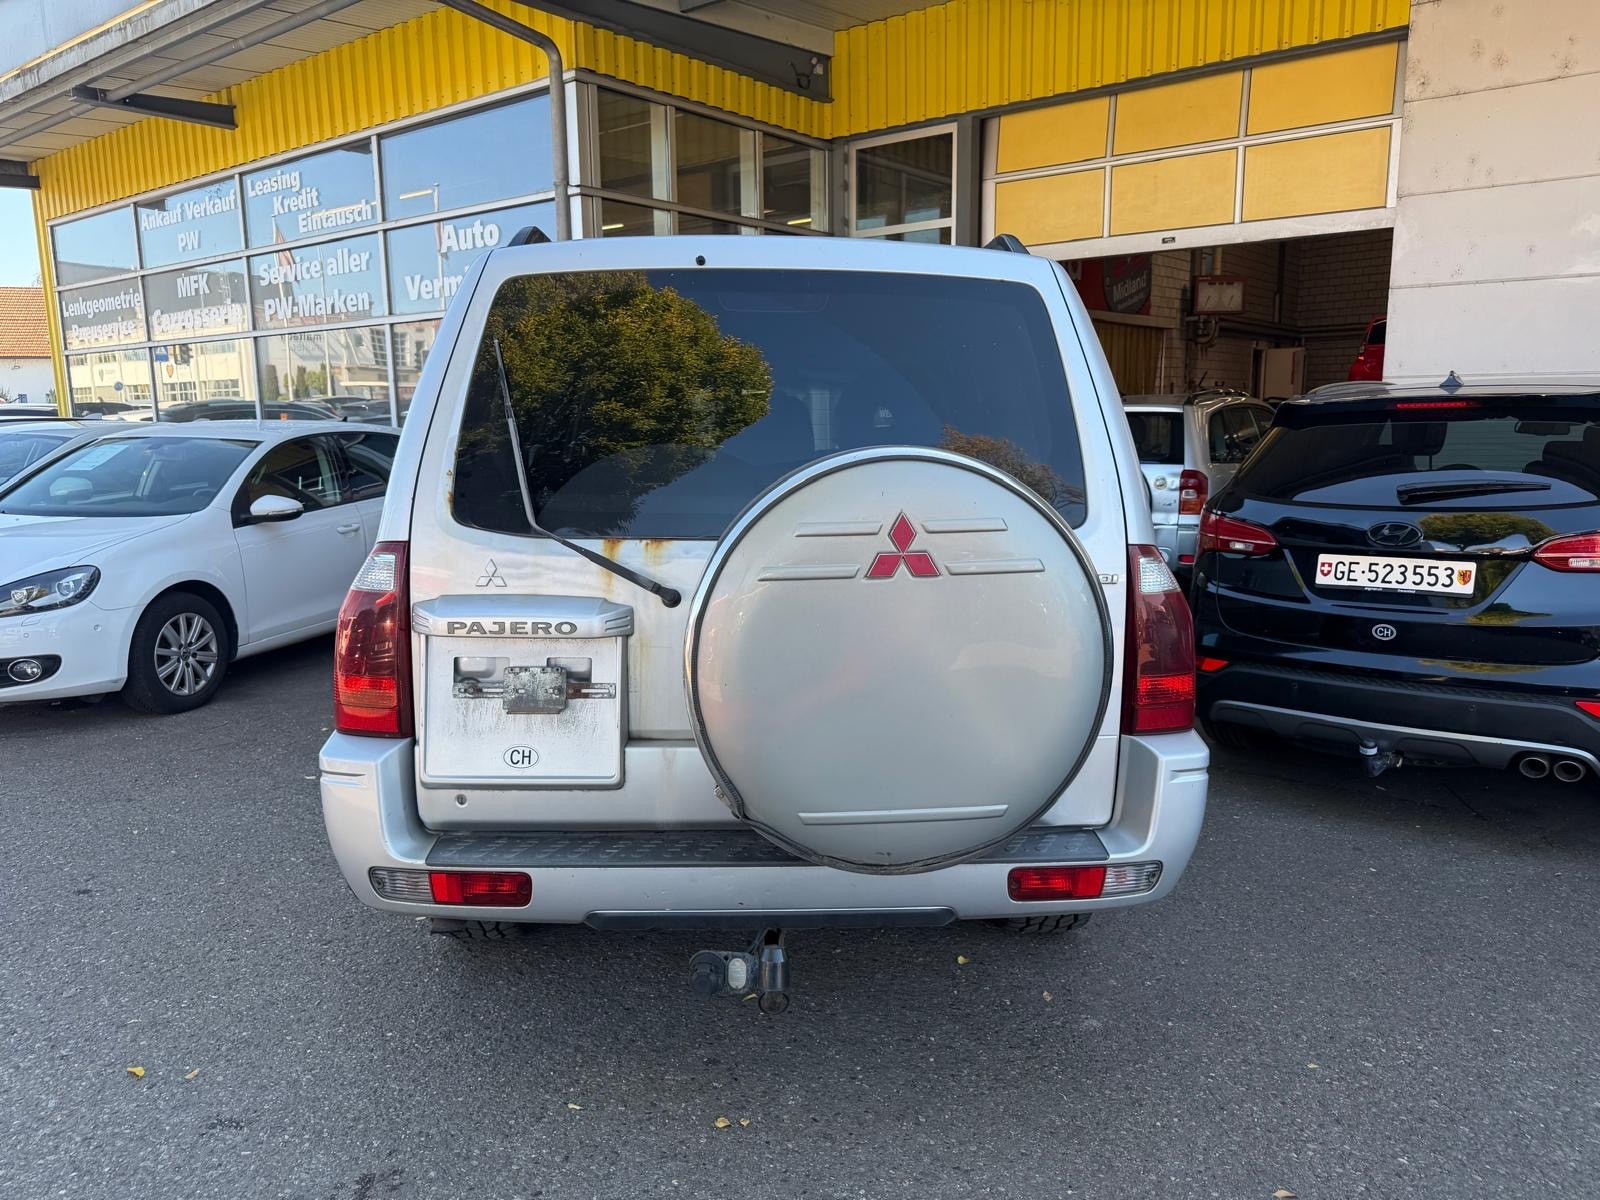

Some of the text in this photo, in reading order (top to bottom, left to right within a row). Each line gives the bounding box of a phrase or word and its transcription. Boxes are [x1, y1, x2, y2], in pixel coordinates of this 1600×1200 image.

[247, 170, 301, 198] Leasing
[141, 190, 237, 232] Ankauf Verkauf
[272, 186, 319, 217] Kredit
[298, 199, 372, 233] Eintausch
[177, 230, 199, 253] PW
[440, 219, 500, 253] Auto
[259, 247, 371, 286] Service aller
[176, 272, 210, 298] MFK
[404, 265, 470, 301] Verm
[1112, 271, 1147, 303] Midland
[264, 288, 371, 322] PW-Marken
[447, 621, 578, 635] PAJERO
[1376, 627, 1393, 638] CH
[509, 750, 533, 765] CH
